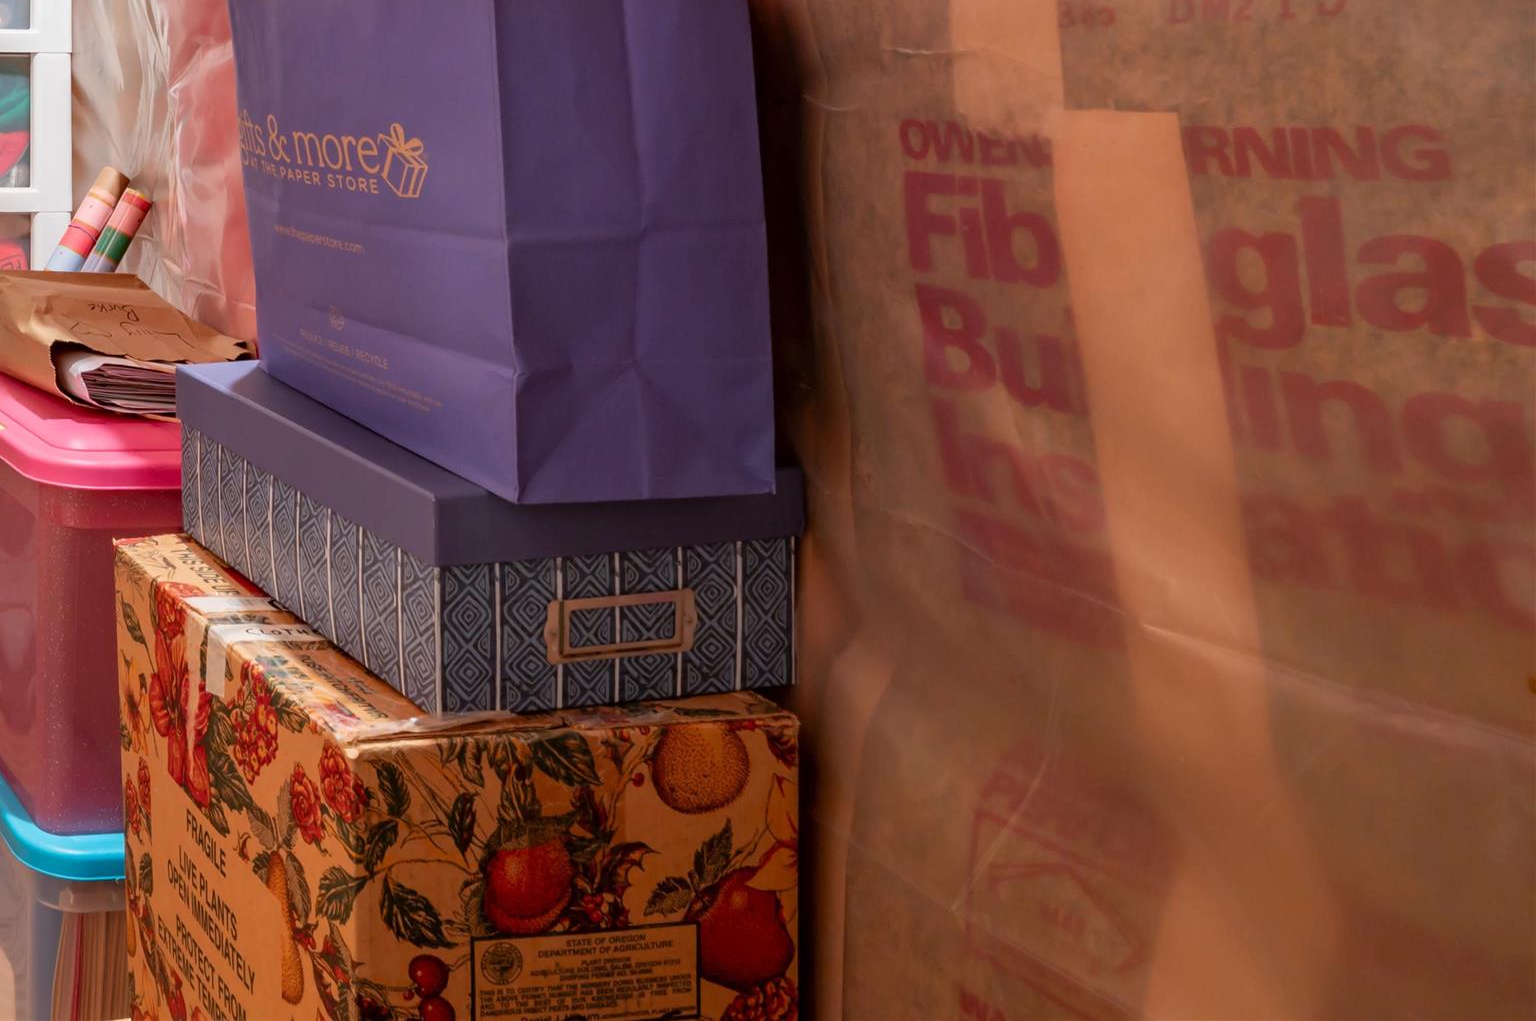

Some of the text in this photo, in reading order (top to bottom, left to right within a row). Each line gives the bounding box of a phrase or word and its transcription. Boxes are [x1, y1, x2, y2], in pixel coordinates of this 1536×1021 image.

[268, 114, 291, 162] &
[292, 130, 380, 174] more
[898, 118, 1452, 181] OWEN RNING
[261, 160, 277, 177] THE
[280, 166, 322, 186] PAPER
[327, 174, 380, 194] STORE
[904, 170, 1536, 350] Fibglas
[354, 348, 389, 370] RECYCLE
[245, 627, 316, 637] CLOTH
[186, 807, 227, 878] FRAGILE
[178, 845, 238, 941] LIVE PLANTS
[157, 913, 196, 991] EXTREME
[167, 858, 256, 995] OPEN IMMEDIATELY
[538, 940, 673, 958] DEPARTMENT OF AGRICULTURE
[566, 933, 646, 948] STATE OF OREGON
[176, 913, 247, 1021] PROTECT FROM
